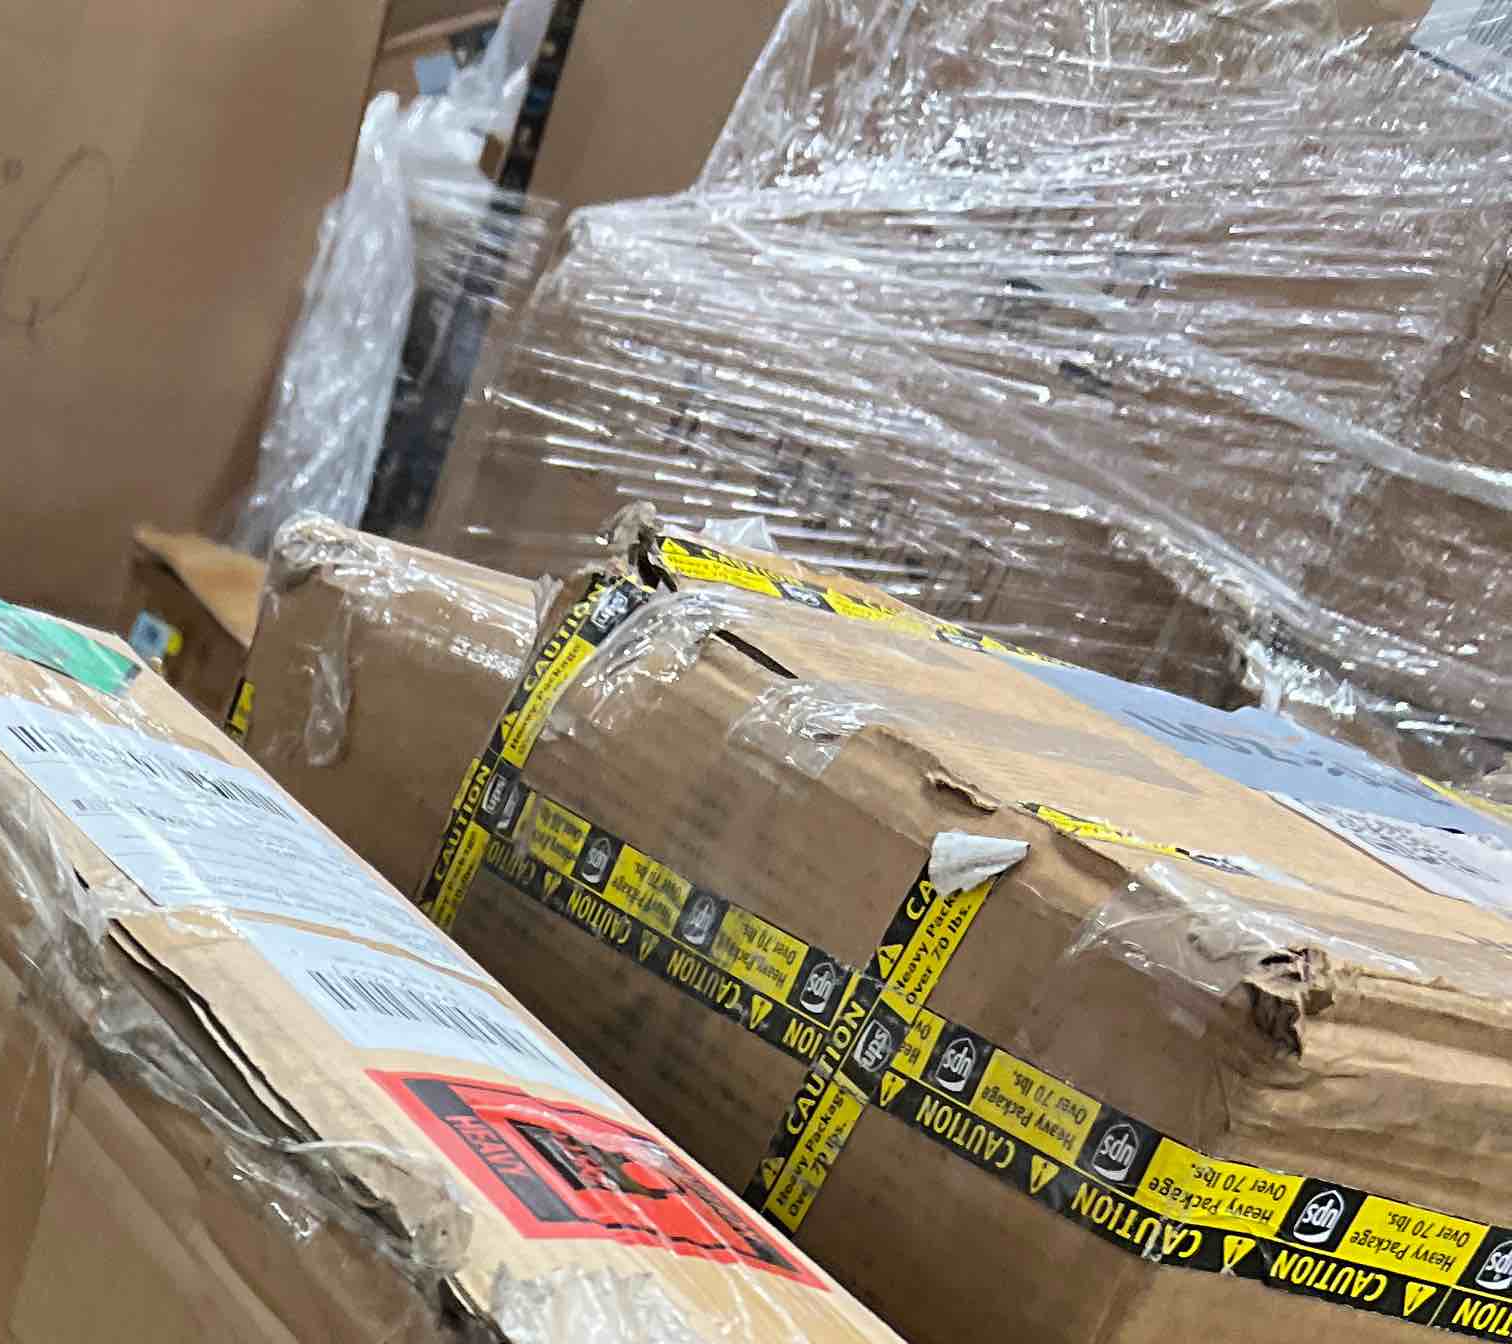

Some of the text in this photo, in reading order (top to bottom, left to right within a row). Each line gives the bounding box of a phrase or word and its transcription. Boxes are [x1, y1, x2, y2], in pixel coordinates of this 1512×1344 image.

[567, 888, 633, 944] CAUTION
[667, 950, 742, 1010] CAUTION
[787, 1001, 866, 1135] CAUTION
[862, 1029, 889, 1068] ups
[944, 1047, 974, 1078] ups
[981, 1085, 1077, 1151] Heavy Package
[1013, 1071, 1088, 1126] Over 70 lbs.
[1101, 1133, 1136, 1167] ups
[915, 1094, 1203, 1261] CAUTION CAUTION
[1148, 1177, 1275, 1225] Heavy Package
[1191, 1163, 1288, 1202] Over 70 lbs.
[1302, 1198, 1339, 1230] ups
[1387, 1210, 1471, 1249] Over 70 lbs.
[1349, 1229, 1458, 1274] Heavy Package
[1269, 1249, 1389, 1303] CAUTION
